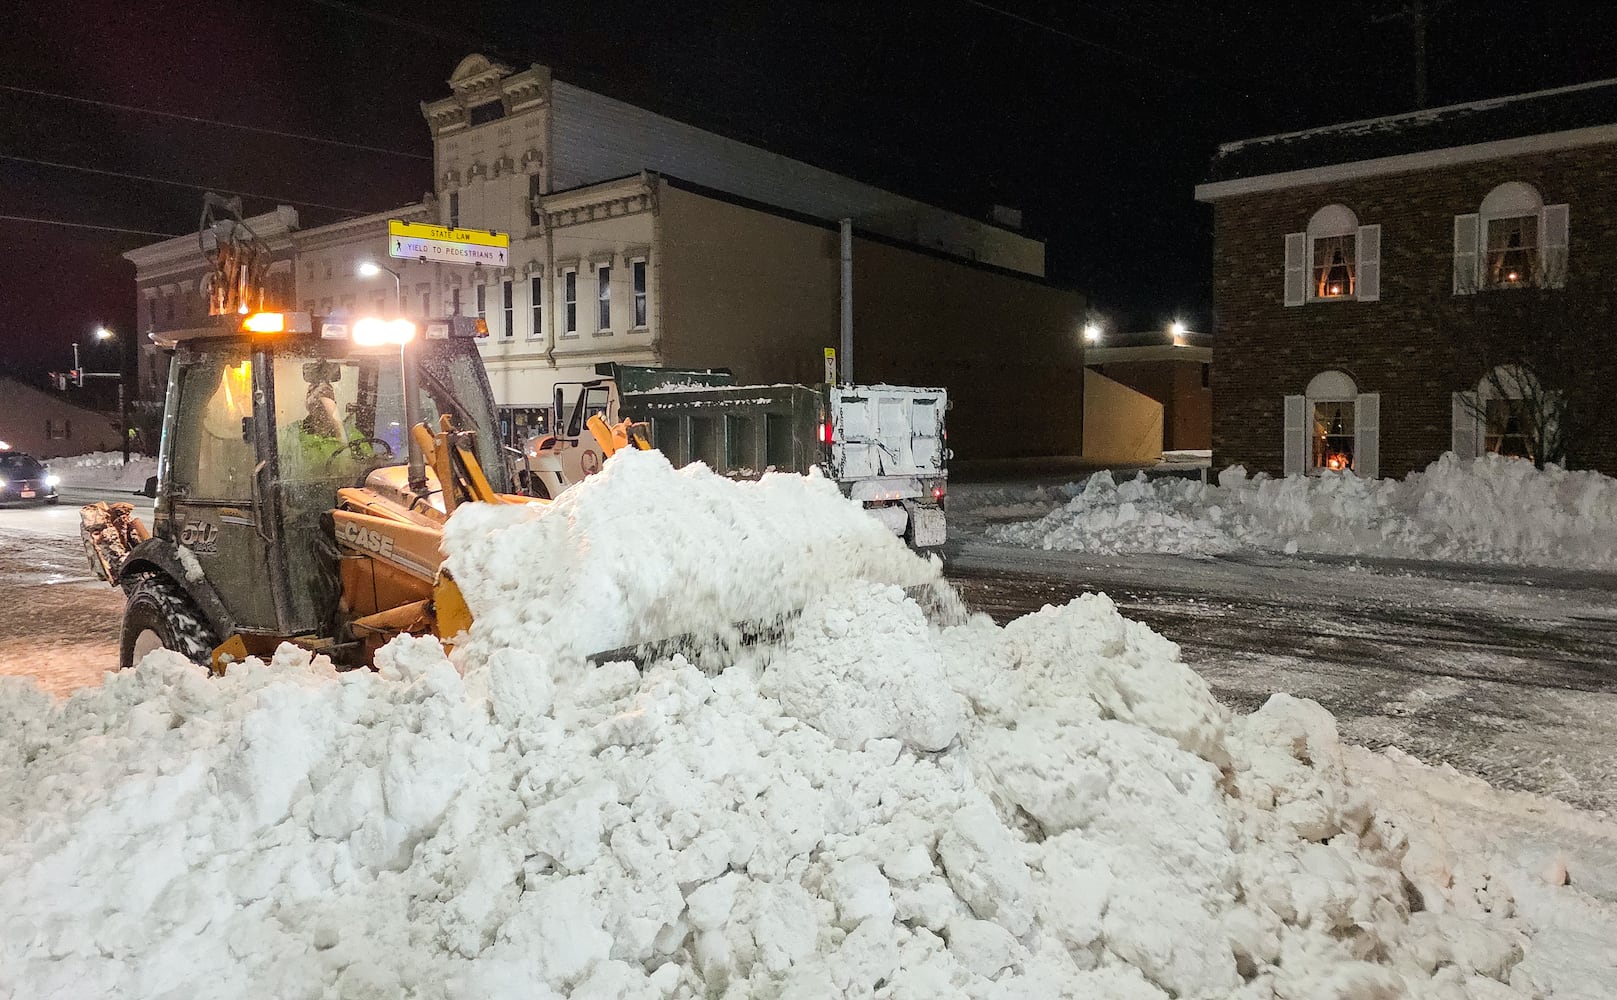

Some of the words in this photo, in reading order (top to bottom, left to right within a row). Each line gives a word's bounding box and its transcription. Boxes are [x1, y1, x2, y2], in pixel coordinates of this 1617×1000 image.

[431, 230, 452, 240] STATE
[456, 233, 470, 241] LAW
[407, 243, 428, 253] YIELD
[432, 246, 441, 254] TO
[445, 247, 494, 260] PEDESTRIANS
[345, 521, 394, 558] CASE
